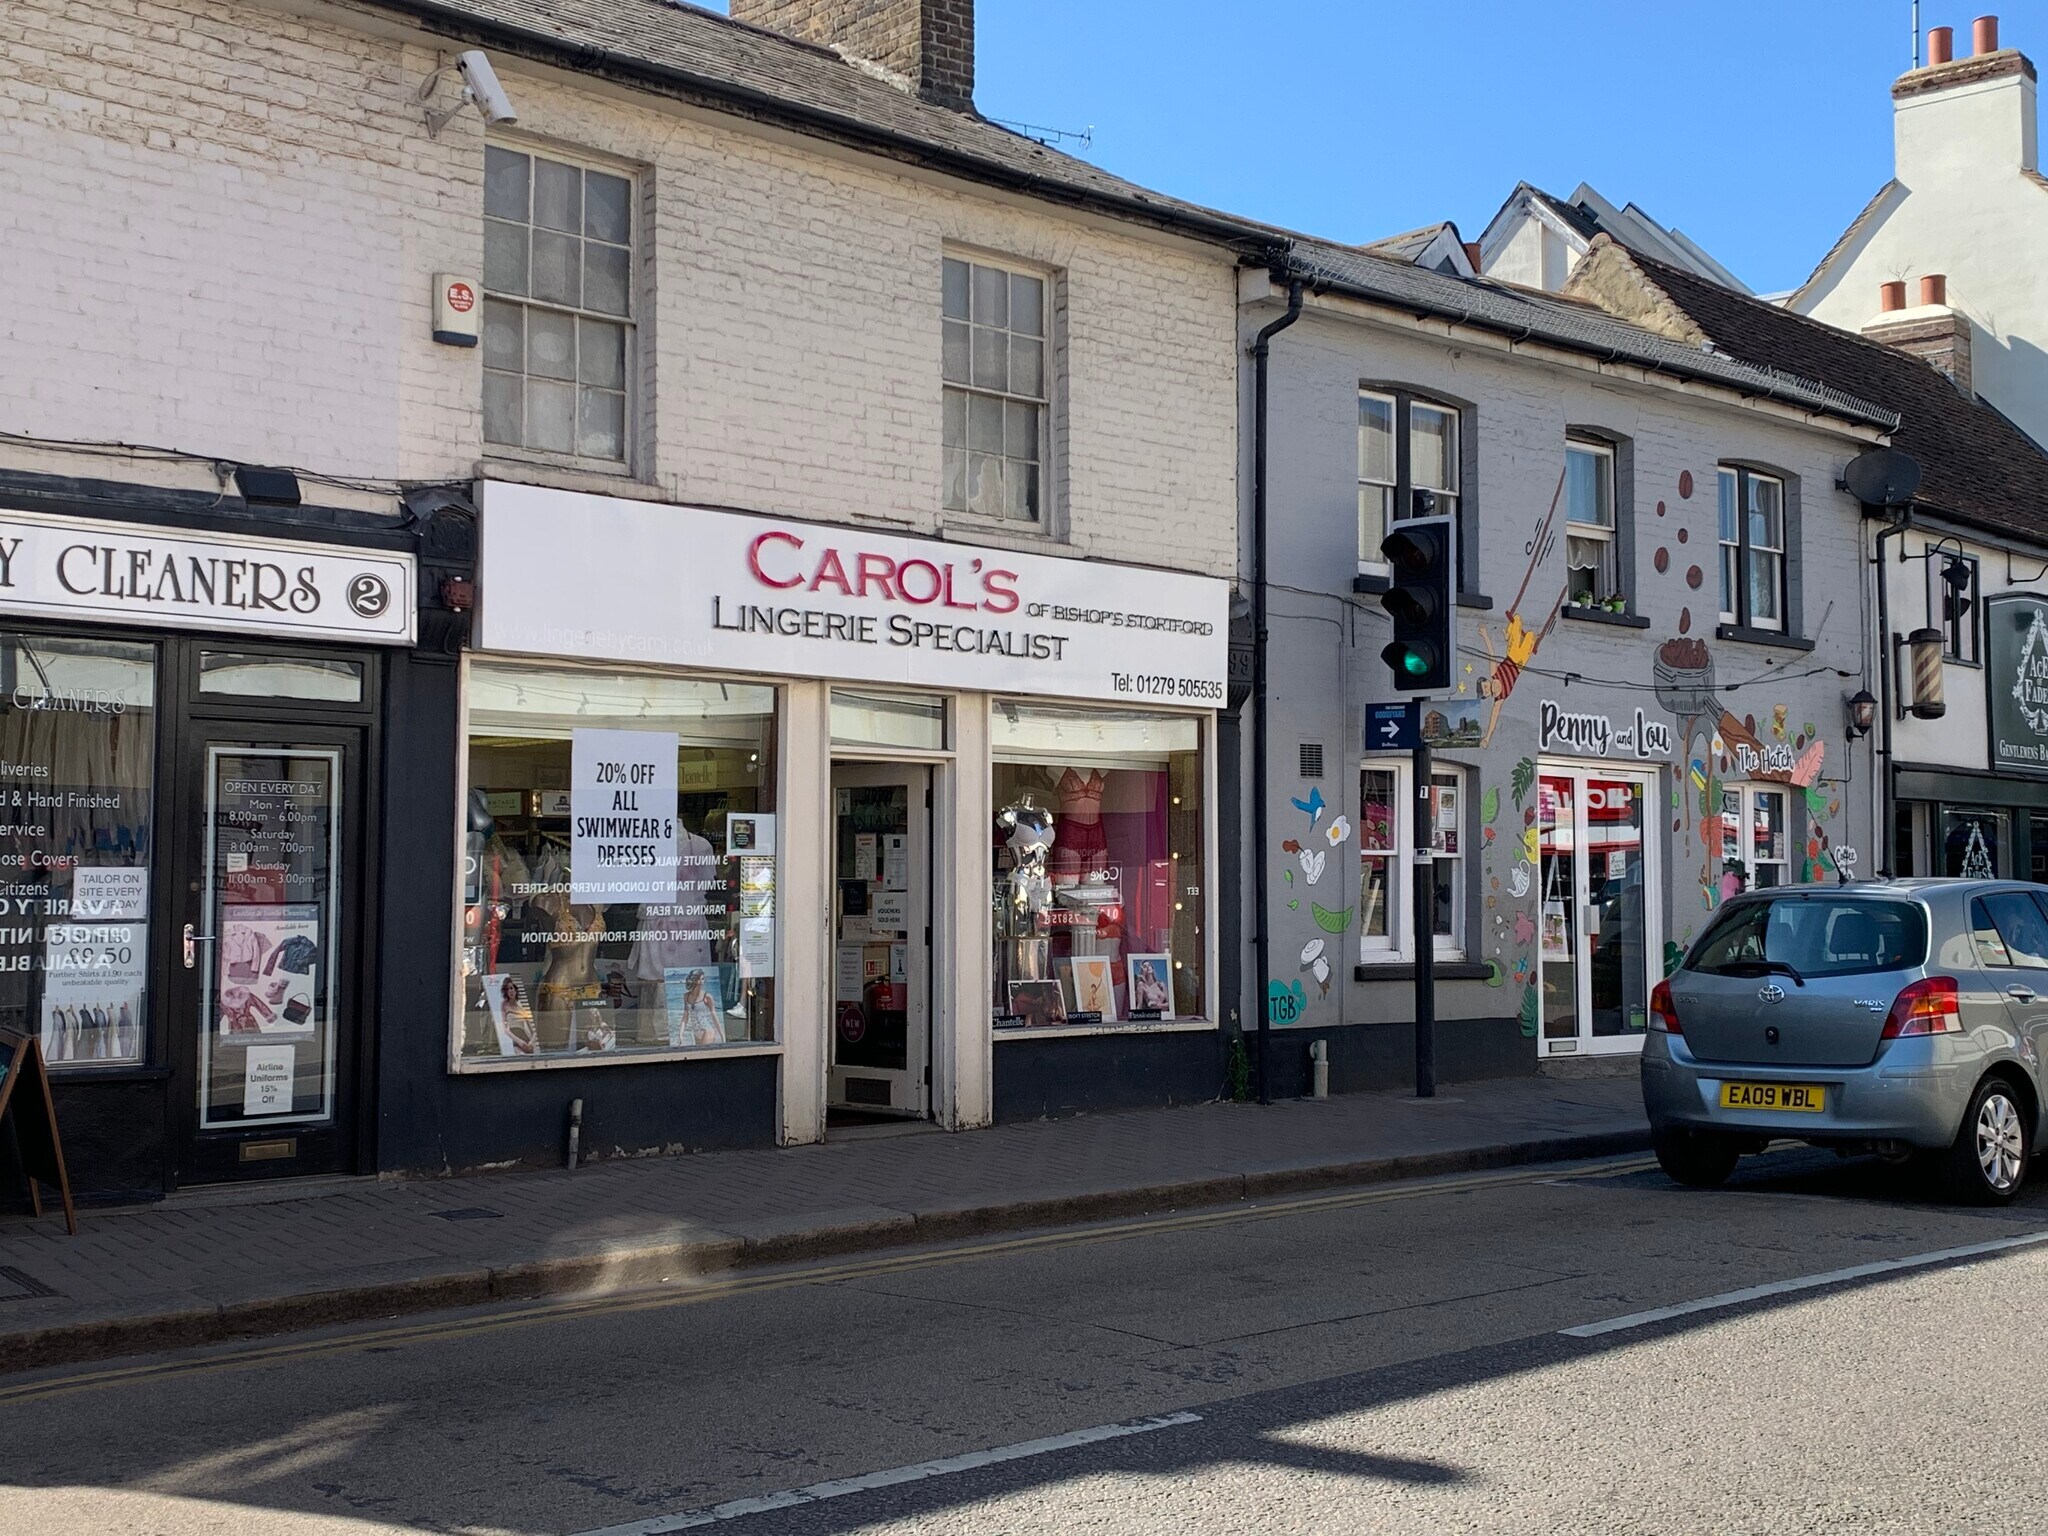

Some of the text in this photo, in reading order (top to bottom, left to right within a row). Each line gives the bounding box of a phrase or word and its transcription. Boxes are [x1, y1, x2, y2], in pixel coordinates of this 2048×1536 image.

[56, 545, 321, 614] CLEANERS
[748, 530, 1021, 614] CAROL'S
[712, 595, 1069, 662] LINGERIE SPECIALIST
[1026, 603, 1214, 636] OF BISHOP'S STORTFORD
[1111, 673, 1223, 699] Tel: 01279 505535
[13, 684, 126, 715] CLEANERS
[1541, 702, 1671, 757] Penny and Lou
[1738, 746, 1794, 773] The Hatch
[596, 762, 656, 785] 20% OFF
[680, 765, 713, 785] hantelle
[225, 782, 257, 793] OPEN
[260, 783, 294, 794] EVERY
[11, 790, 22, 806] &
[28, 791, 63, 807] Hand
[68, 792, 120, 809] Finished
[249, 800, 272, 810] Mon
[283, 800, 298, 810] Fri
[612, 790, 639, 811] ALL
[229, 811, 268, 821] 8.00am
[278, 812, 317, 825] 6.00pm
[250, 829, 295, 841] Saturday
[577, 817, 672, 839] SWIMWEAR &
[231, 842, 269, 853] 800am
[597, 845, 656, 867] DRESSES
[31, 850, 79, 865] Covers
[255, 860, 290, 872] Sunday
[82, 874, 139, 884] TAILOR ON
[79, 887, 142, 897] SITE EVERY
[69, 947, 132, 965] £950
[1270, 997, 1296, 1020] TGB
[257, 1063, 284, 1072] Airline
[250, 1074, 289, 1083] Uniforms
[261, 1085, 277, 1093] 15%
[1729, 1086, 1815, 1108] EA09 WBL
[262, 1095, 275, 1104] Off
